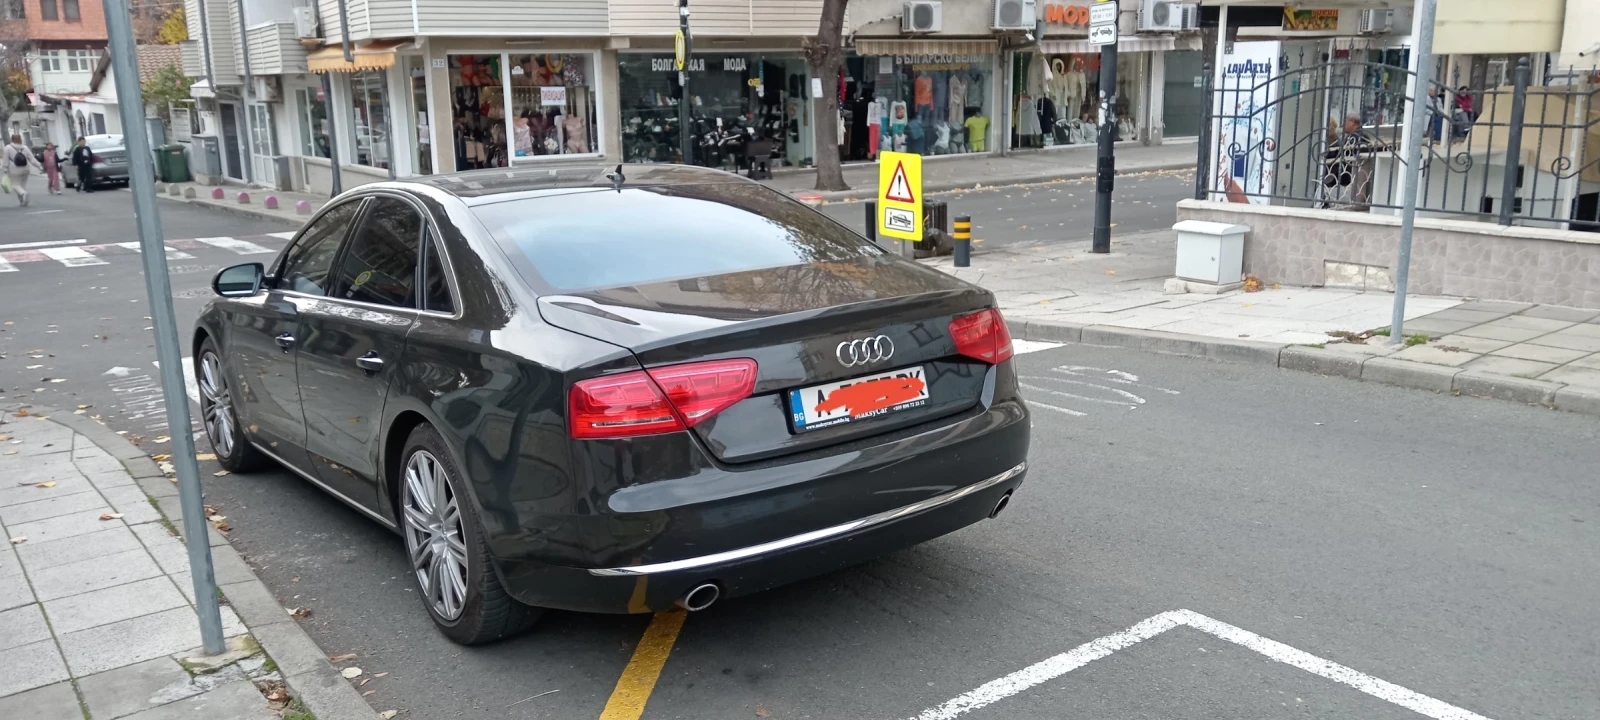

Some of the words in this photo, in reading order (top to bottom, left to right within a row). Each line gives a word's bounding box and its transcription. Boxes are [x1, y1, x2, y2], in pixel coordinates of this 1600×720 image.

[651, 58, 705, 71] БОЛГАКАЯ
[723, 57, 747, 71] МОДА
[794, 412, 805, 421] BG
